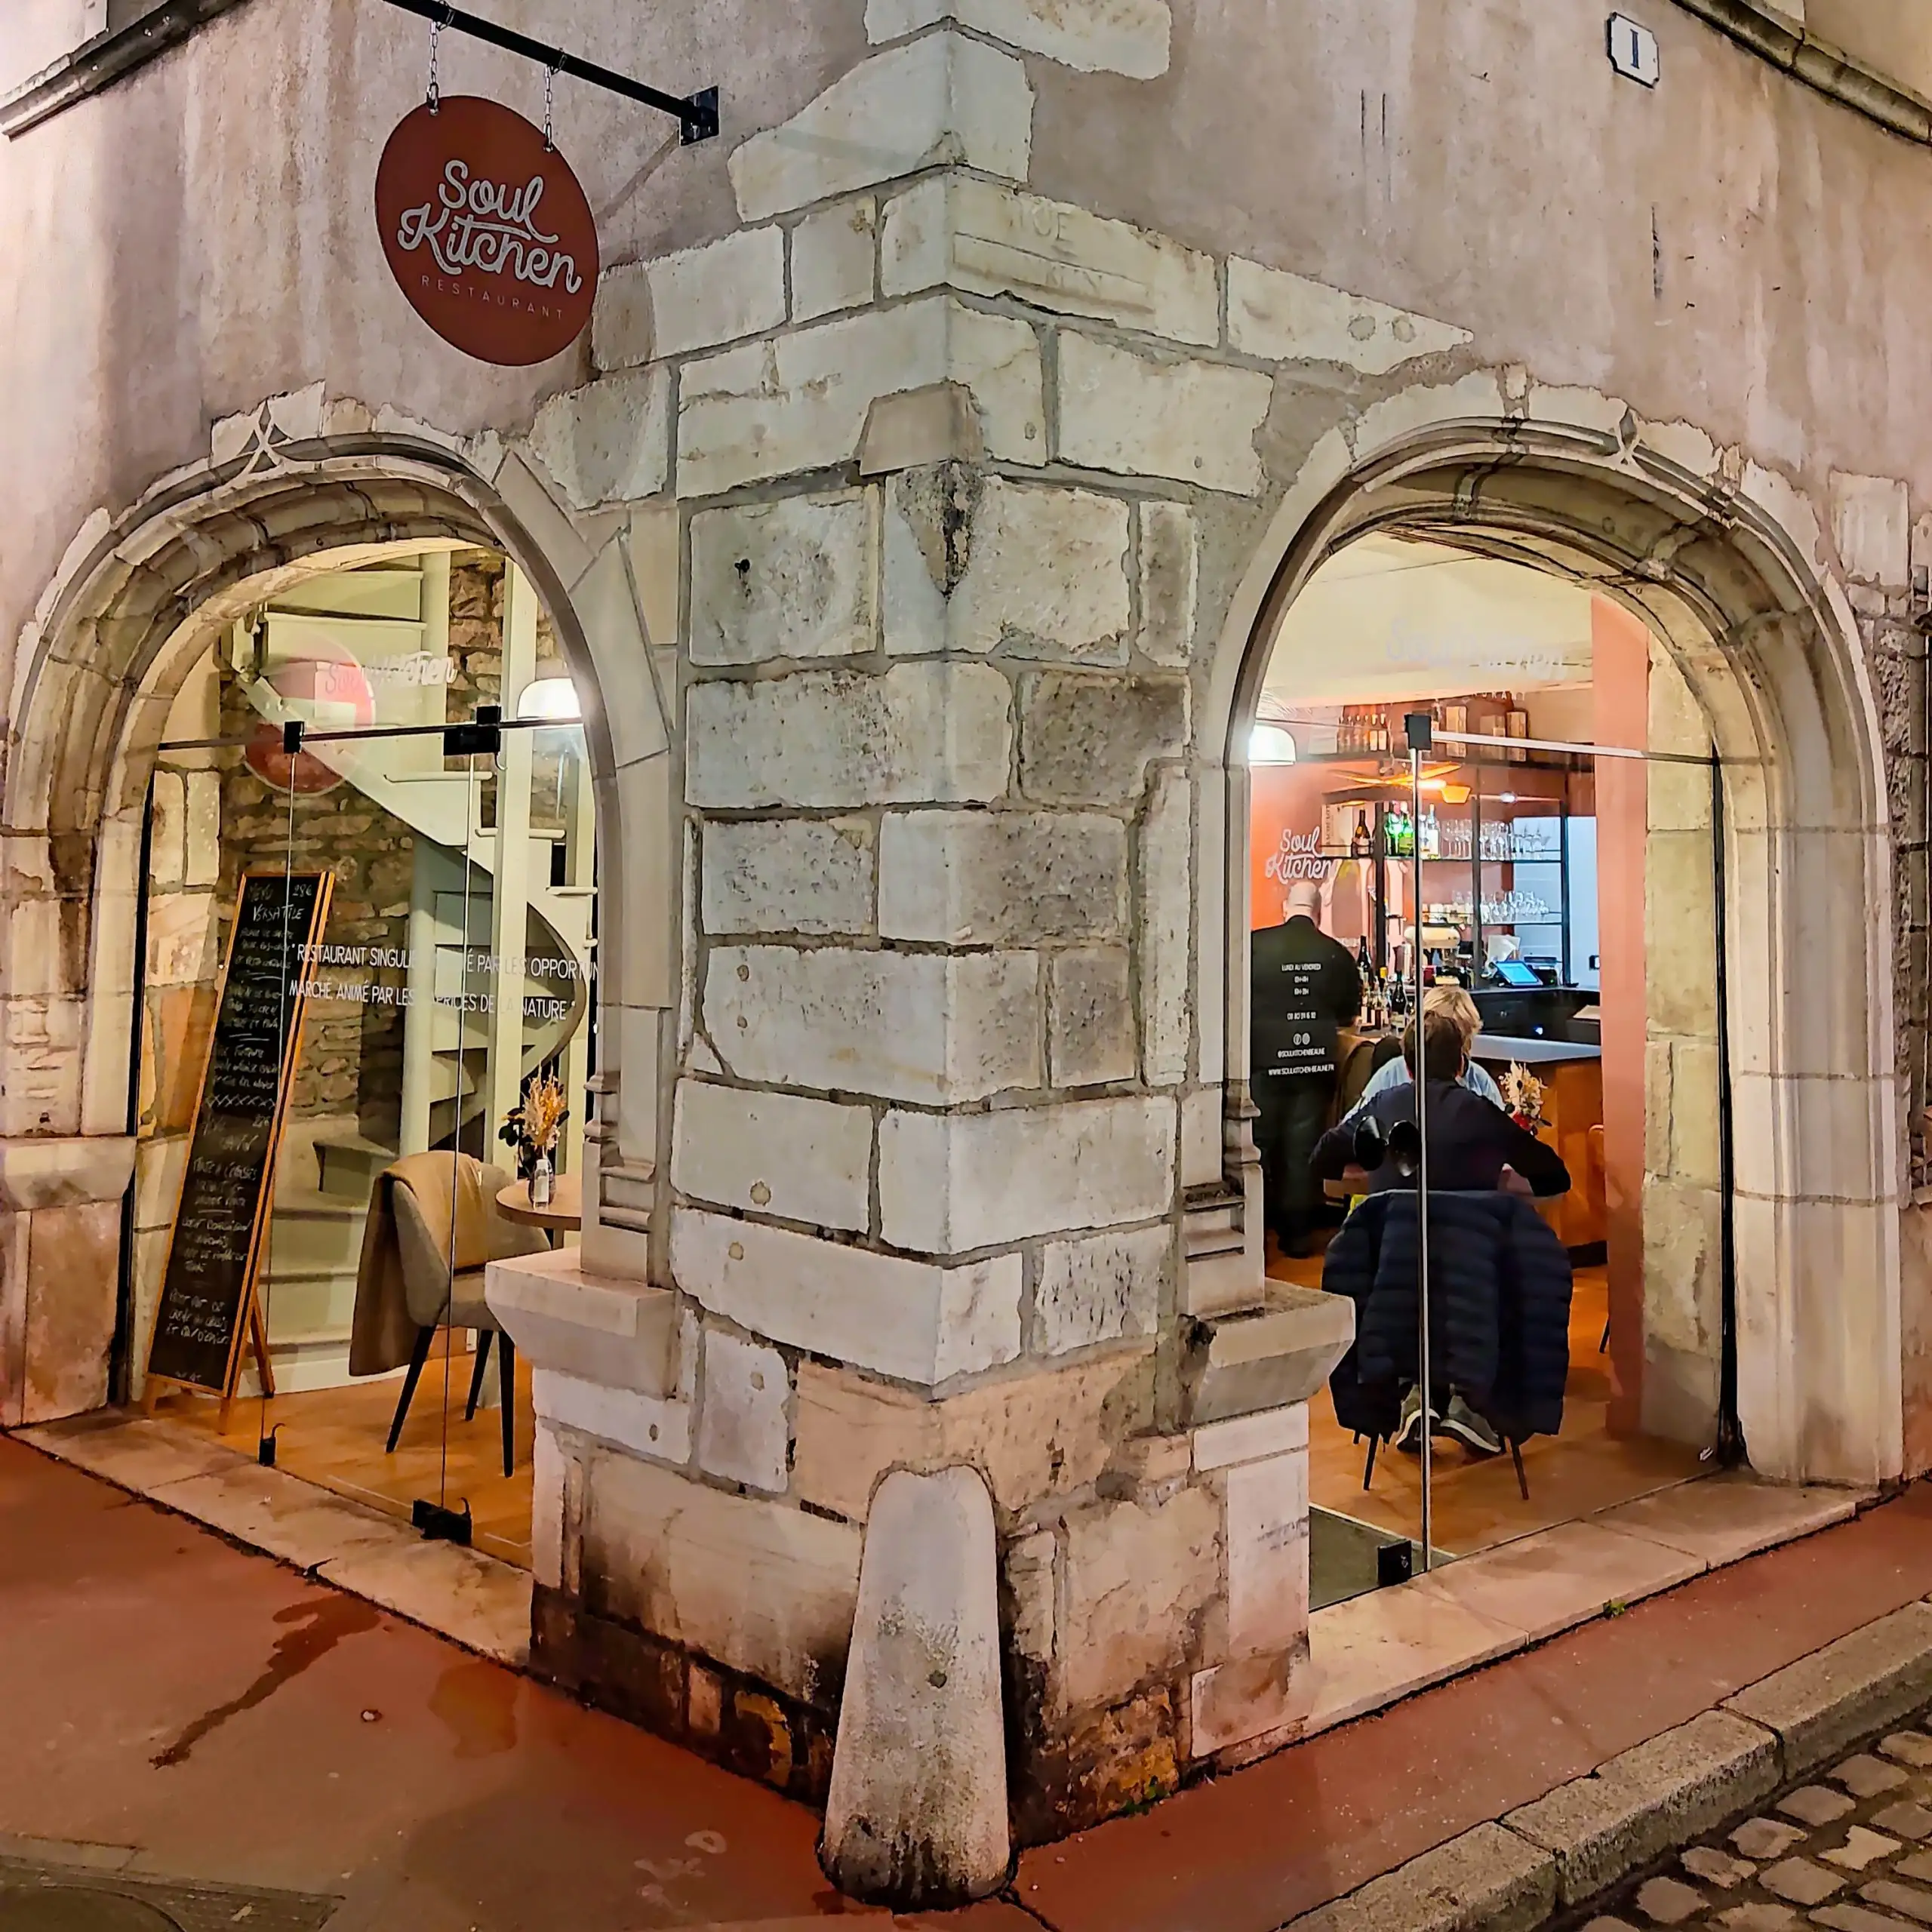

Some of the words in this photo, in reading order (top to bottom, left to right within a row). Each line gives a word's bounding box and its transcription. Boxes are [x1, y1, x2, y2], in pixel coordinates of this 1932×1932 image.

[438, 159, 559, 244] Soul
[397, 202, 583, 294] Kitchen
[420, 274, 563, 321] RESTAURANT
[1279, 826, 1326, 857] Soul
[1265, 852, 1334, 885] Kitchen
[297, 943, 367, 966] RESTAURANT
[336, 979, 369, 1003] ANIMÉ
[371, 986, 393, 1005] PAR
[395, 987, 415, 1007] LES
[480, 993, 496, 1014] DE
